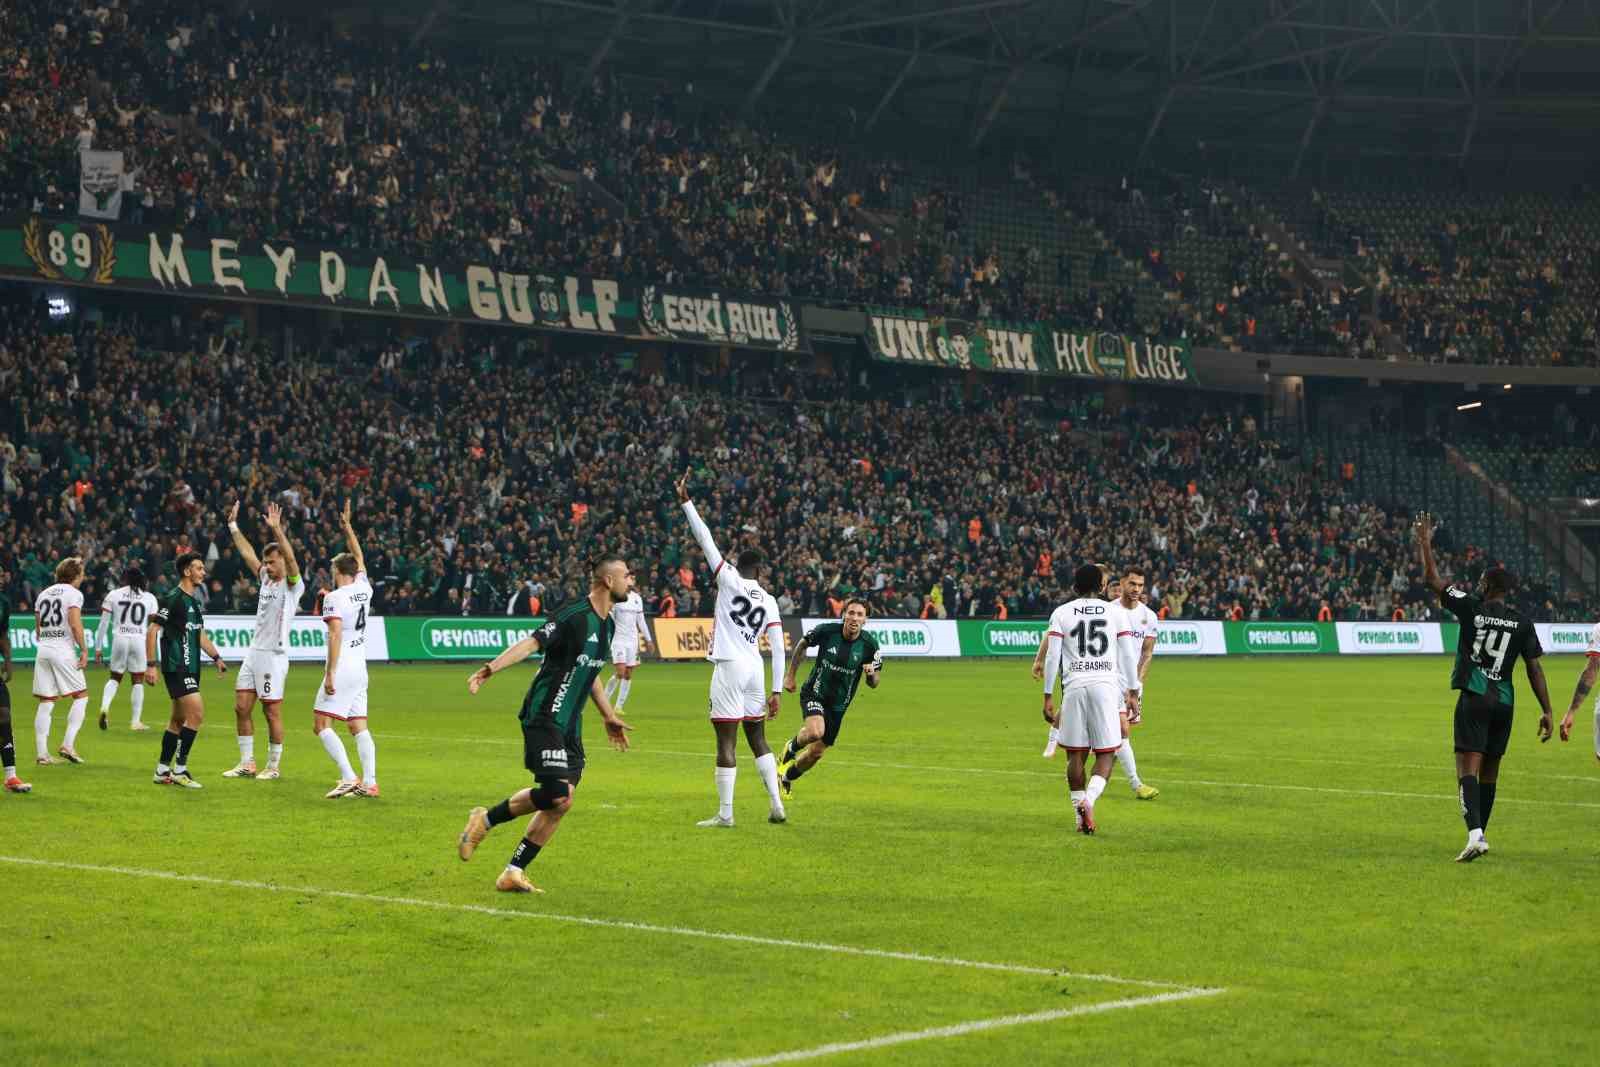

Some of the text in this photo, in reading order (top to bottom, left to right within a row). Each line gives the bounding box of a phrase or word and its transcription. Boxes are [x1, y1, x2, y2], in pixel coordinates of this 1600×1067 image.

[48, 231, 92, 268] 89
[149, 233, 450, 314] MEYDAN
[726, 302, 782, 340] RUH
[987, 329, 1040, 371] HM
[1052, 331, 1096, 374] HM
[40, 598, 64, 628] 23
[118, 601, 146, 626] 70
[354, 603, 367, 634] 4
[729, 595, 767, 636] 29
[1073, 606, 1105, 615] NED
[892, 630, 926, 646] BABA
[1070, 618, 1109, 658] 15
[1171, 630, 1198, 644] BABA
[263, 681, 272, 694] 6
